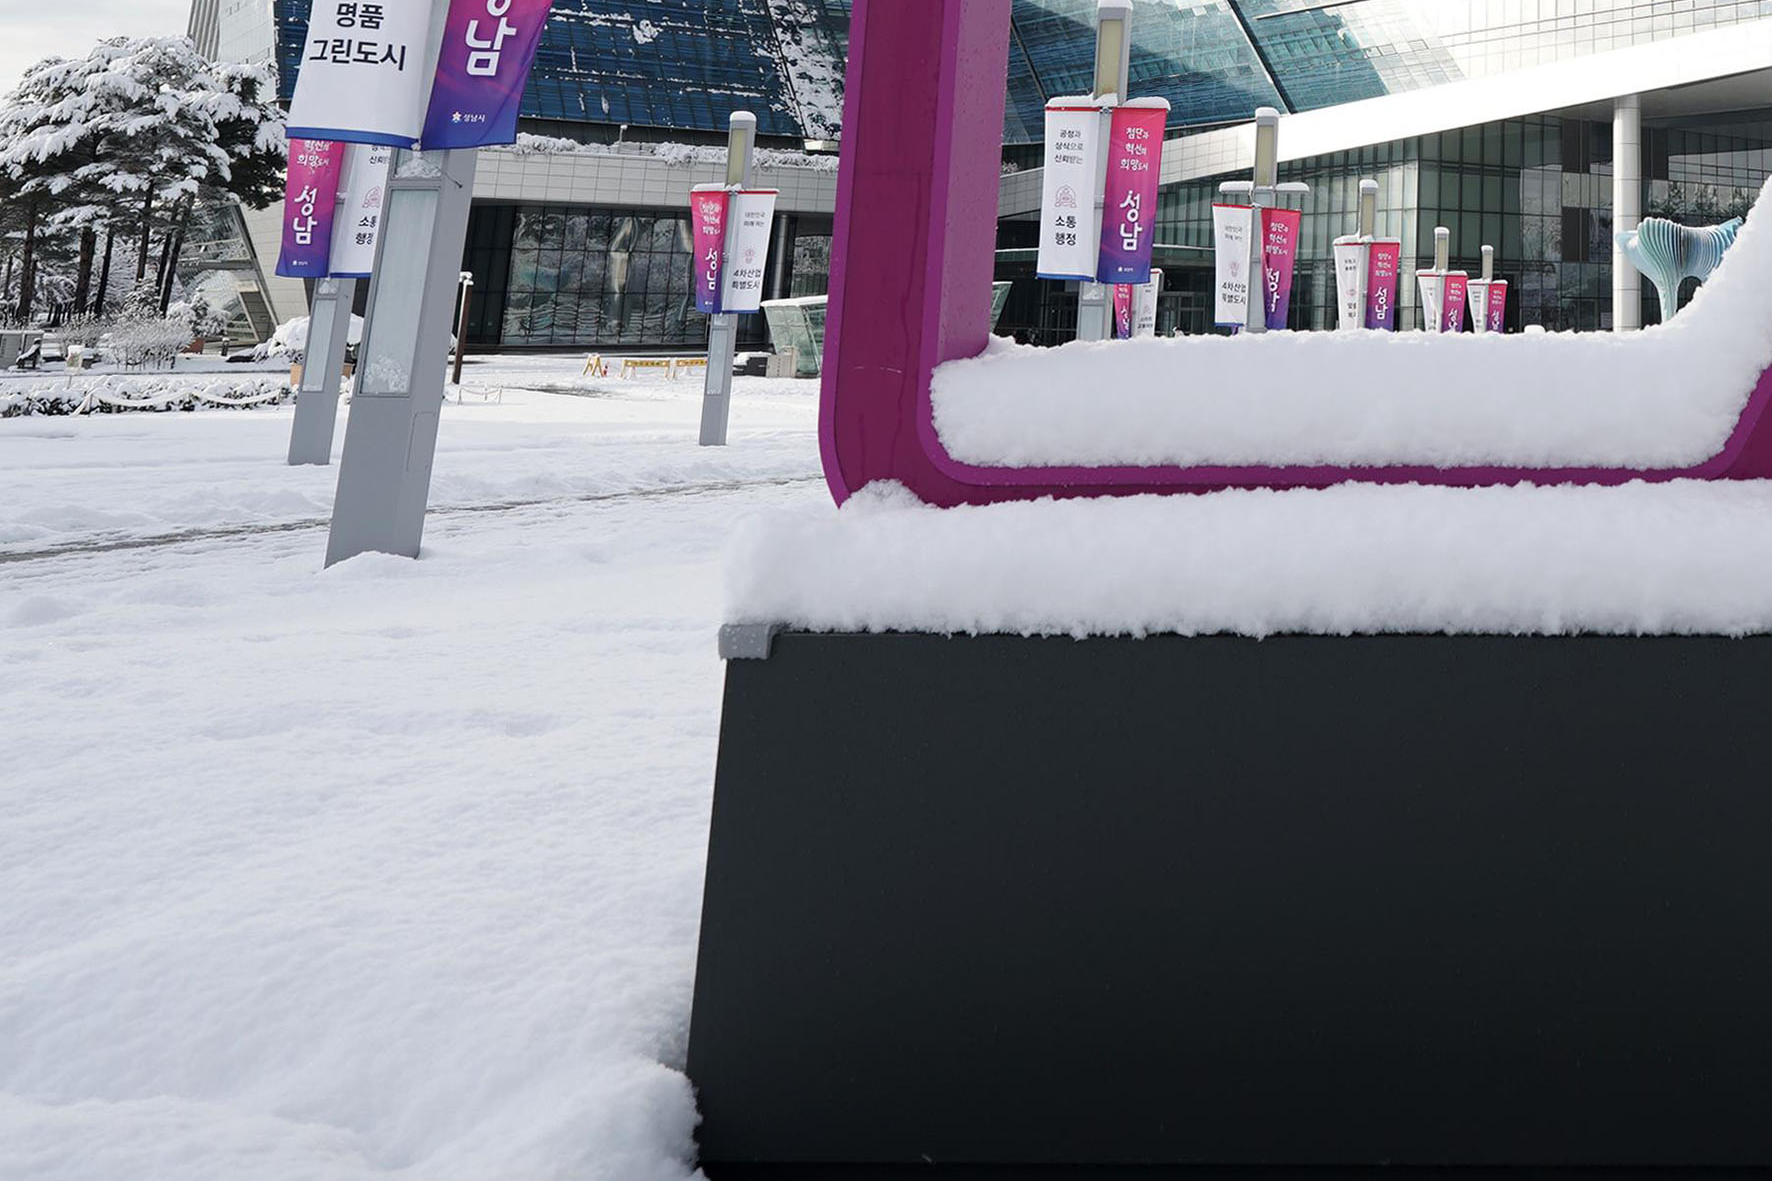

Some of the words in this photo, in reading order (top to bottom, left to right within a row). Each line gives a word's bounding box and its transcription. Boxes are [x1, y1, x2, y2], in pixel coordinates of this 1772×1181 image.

[337, 3, 384, 30] 명품
[309, 39, 406, 71] 그린도시
[1125, 127, 1149, 140] 첨단과
[297, 154, 329, 168] 희망도시
[293, 185, 318, 245] 성남
[1055, 215, 1077, 229] 소통
[1119, 190, 1143, 251] 성남
[1055, 232, 1077, 246] 행정
[733, 269, 762, 279] 4차산업
[1375, 286, 1389, 320] 성남
